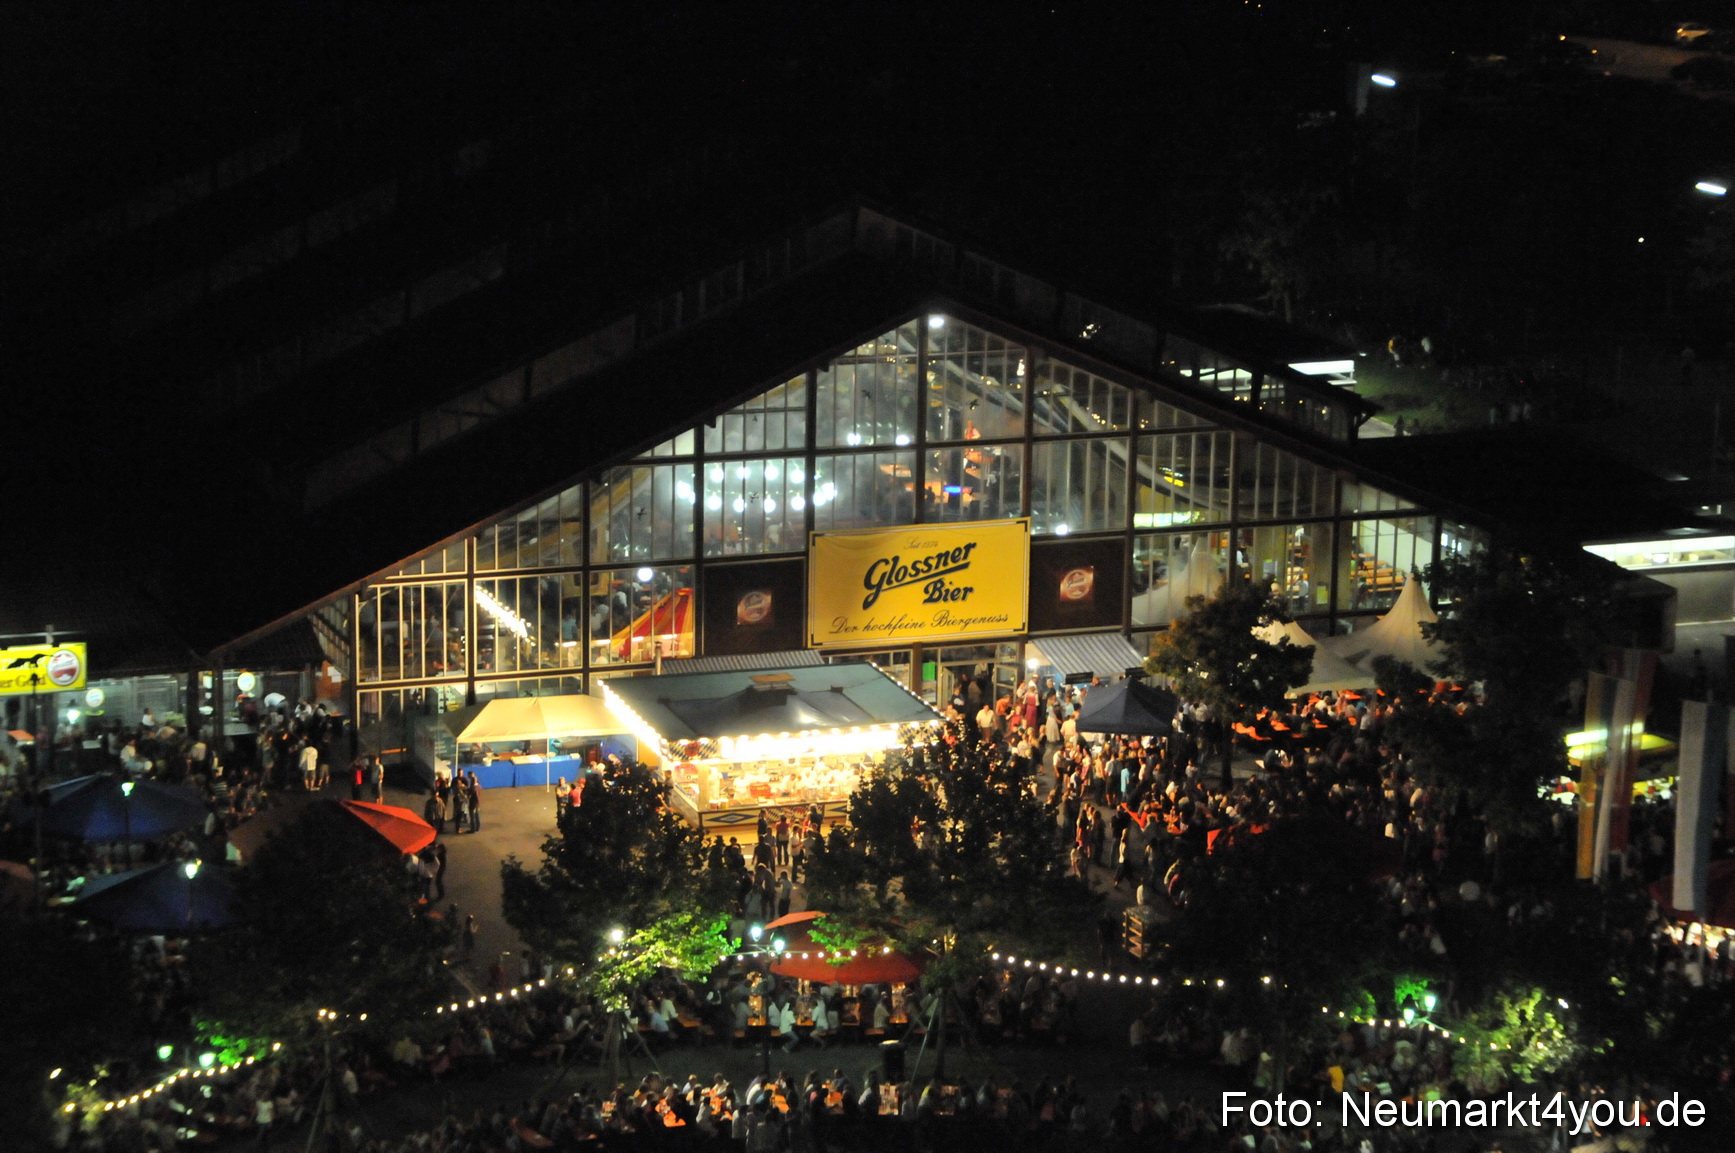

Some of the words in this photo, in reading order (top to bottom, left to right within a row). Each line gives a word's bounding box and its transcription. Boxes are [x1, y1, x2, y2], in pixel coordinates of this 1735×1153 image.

[862, 542, 977, 610] Glossner
[922, 577, 975, 604] Bier
[829, 616, 859, 634] Der
[863, 614, 926, 636] hochfeine
[932, 610, 1009, 634] Biergenuss
